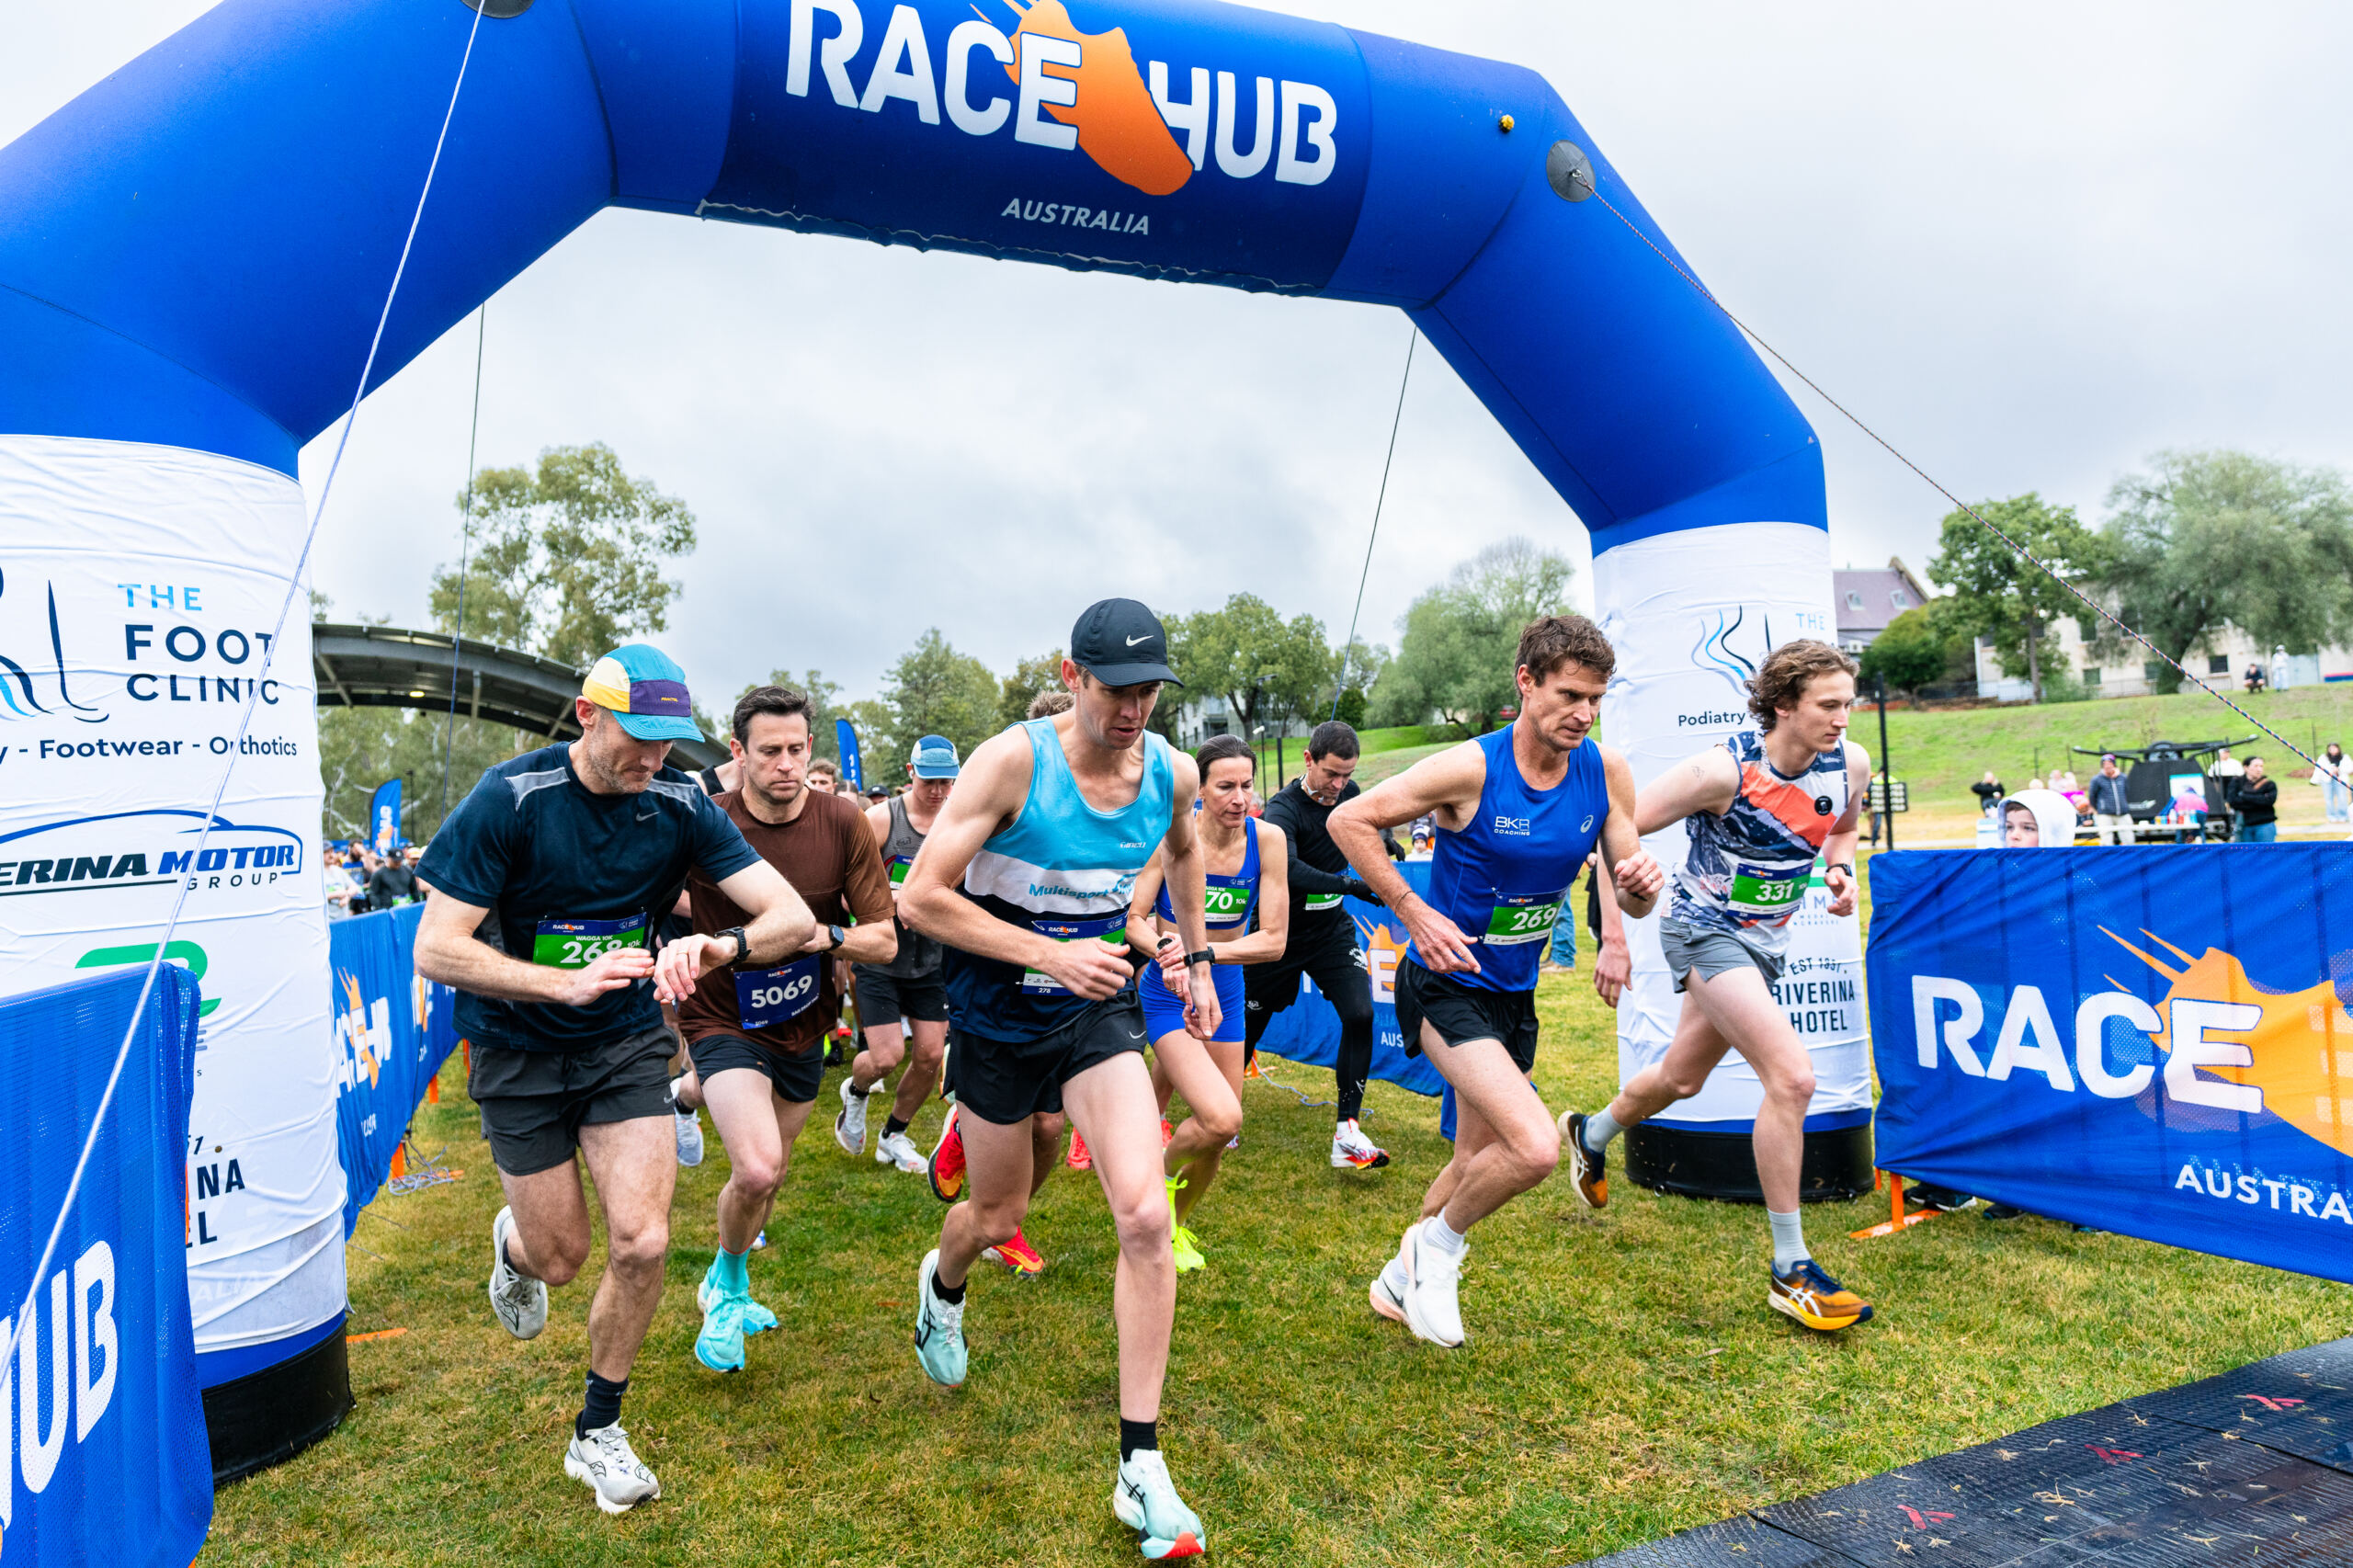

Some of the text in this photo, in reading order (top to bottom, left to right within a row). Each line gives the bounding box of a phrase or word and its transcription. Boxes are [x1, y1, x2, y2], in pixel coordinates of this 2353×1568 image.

[786, 0, 1337, 186] RACE HUB
[1001, 197, 1151, 236] AUSTRALIA
[118, 584, 202, 611] THE
[1795, 613, 1824, 630] THE
[125, 623, 273, 666] FOOT
[127, 674, 279, 705] CLINIC
[1678, 711, 1745, 727] Podiatry
[40, 738, 184, 759] Footwear
[1494, 828, 1530, 836] COACHING
[158, 845, 295, 875] MOTOR
[188, 872, 278, 891] GROUP
[1029, 883, 1110, 900] Multisport
[1755, 882, 1794, 902] 331
[1509, 907, 1557, 931] 269
[1790, 957, 1813, 975] EST
[751, 974, 813, 1008] 5069
[1771, 980, 1855, 1006] RIVERINA
[1790, 1009, 1847, 1033] HOTEL
[1912, 974, 2264, 1114] RACE
[2175, 1164, 2353, 1225] AUSTRA
[0, 1240, 119, 1531] UB
